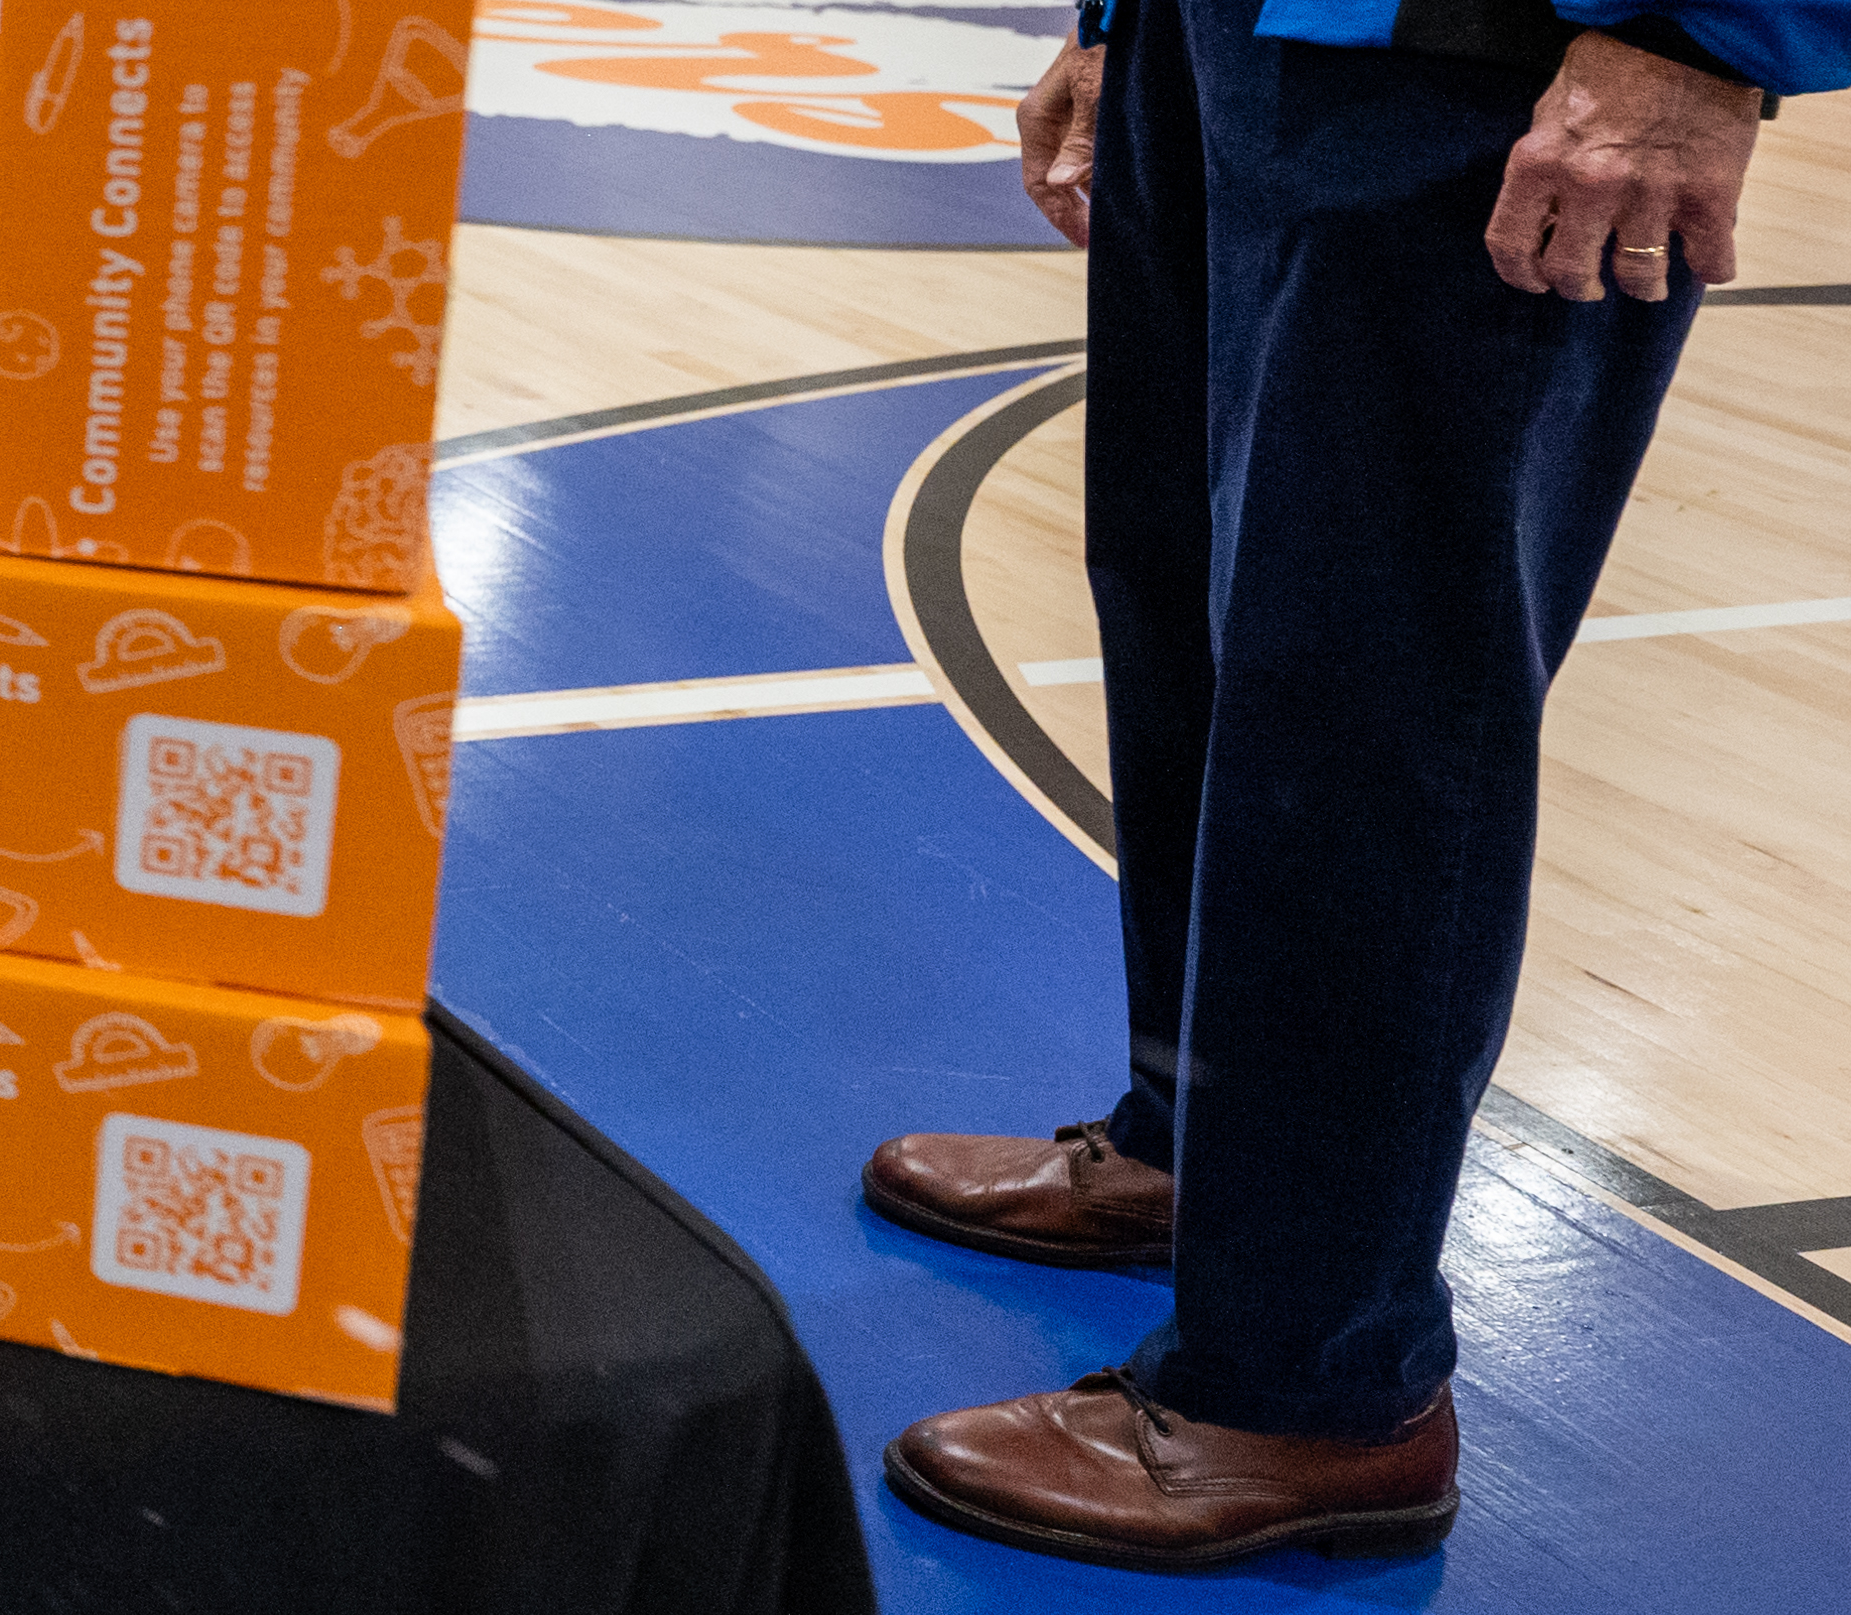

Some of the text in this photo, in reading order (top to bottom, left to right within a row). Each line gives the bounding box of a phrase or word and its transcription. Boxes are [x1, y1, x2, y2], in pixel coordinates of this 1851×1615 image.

[69, 18, 154, 515] Community Connects
[148, 83, 209, 463] Use your phone camera to
[197, 80, 257, 473] scan the QR code to access
[243, 67, 312, 492] resources in your community
